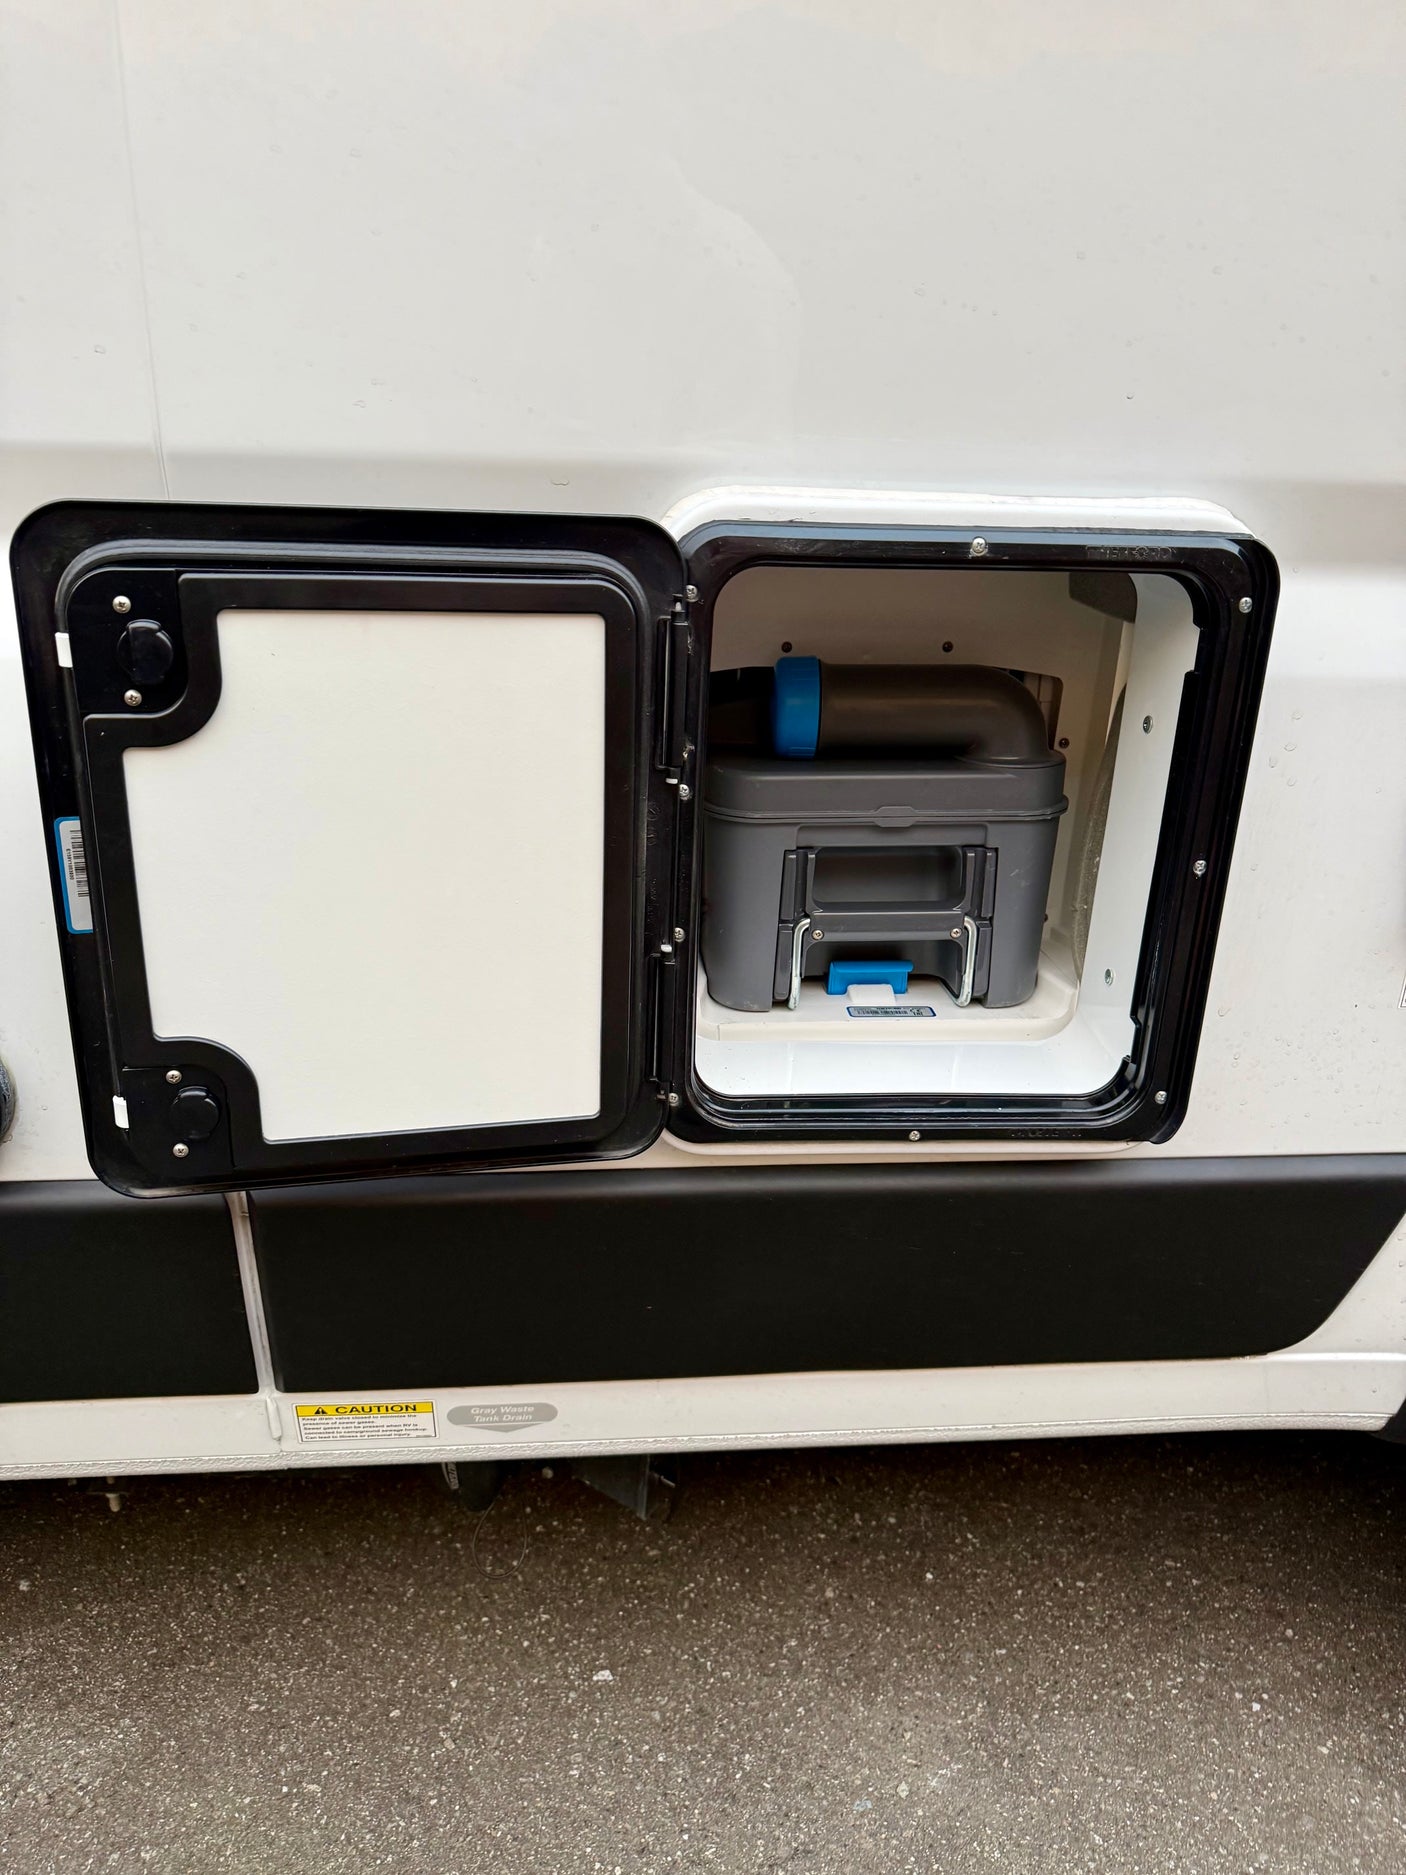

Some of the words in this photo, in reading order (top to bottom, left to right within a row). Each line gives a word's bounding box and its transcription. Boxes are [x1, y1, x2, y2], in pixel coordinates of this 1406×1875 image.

[335, 1404, 417, 1413] CAUTION
[470, 1406, 498, 1415] Gray
[500, 1405, 534, 1414] Waste
[473, 1414, 500, 1423] Tank
[502, 1413, 533, 1422] Drain
